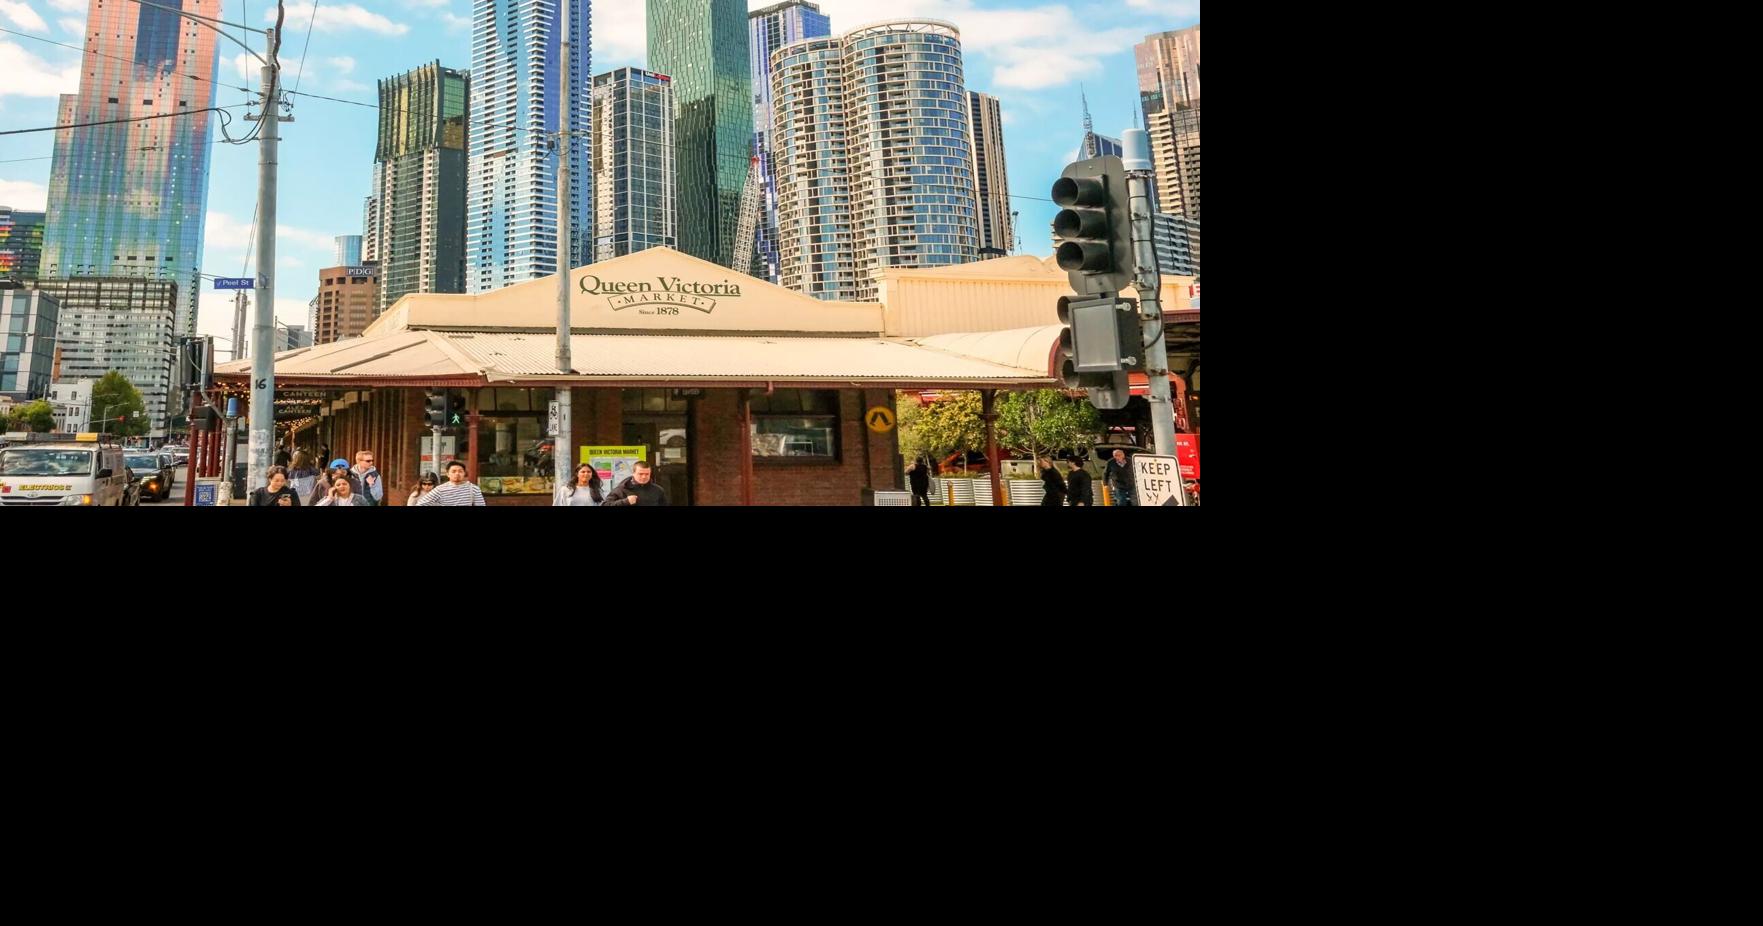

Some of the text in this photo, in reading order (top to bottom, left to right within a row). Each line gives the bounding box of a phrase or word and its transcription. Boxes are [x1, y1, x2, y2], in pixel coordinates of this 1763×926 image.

[579, 275, 741, 295] Queen Victoria
[623, 292, 701, 306] MARKET
[656, 306, 680, 316] 1878
[255, 378, 267, 390] 16
[1140, 462, 1171, 476] KEEP
[1144, 479, 1172, 493] LEFT
